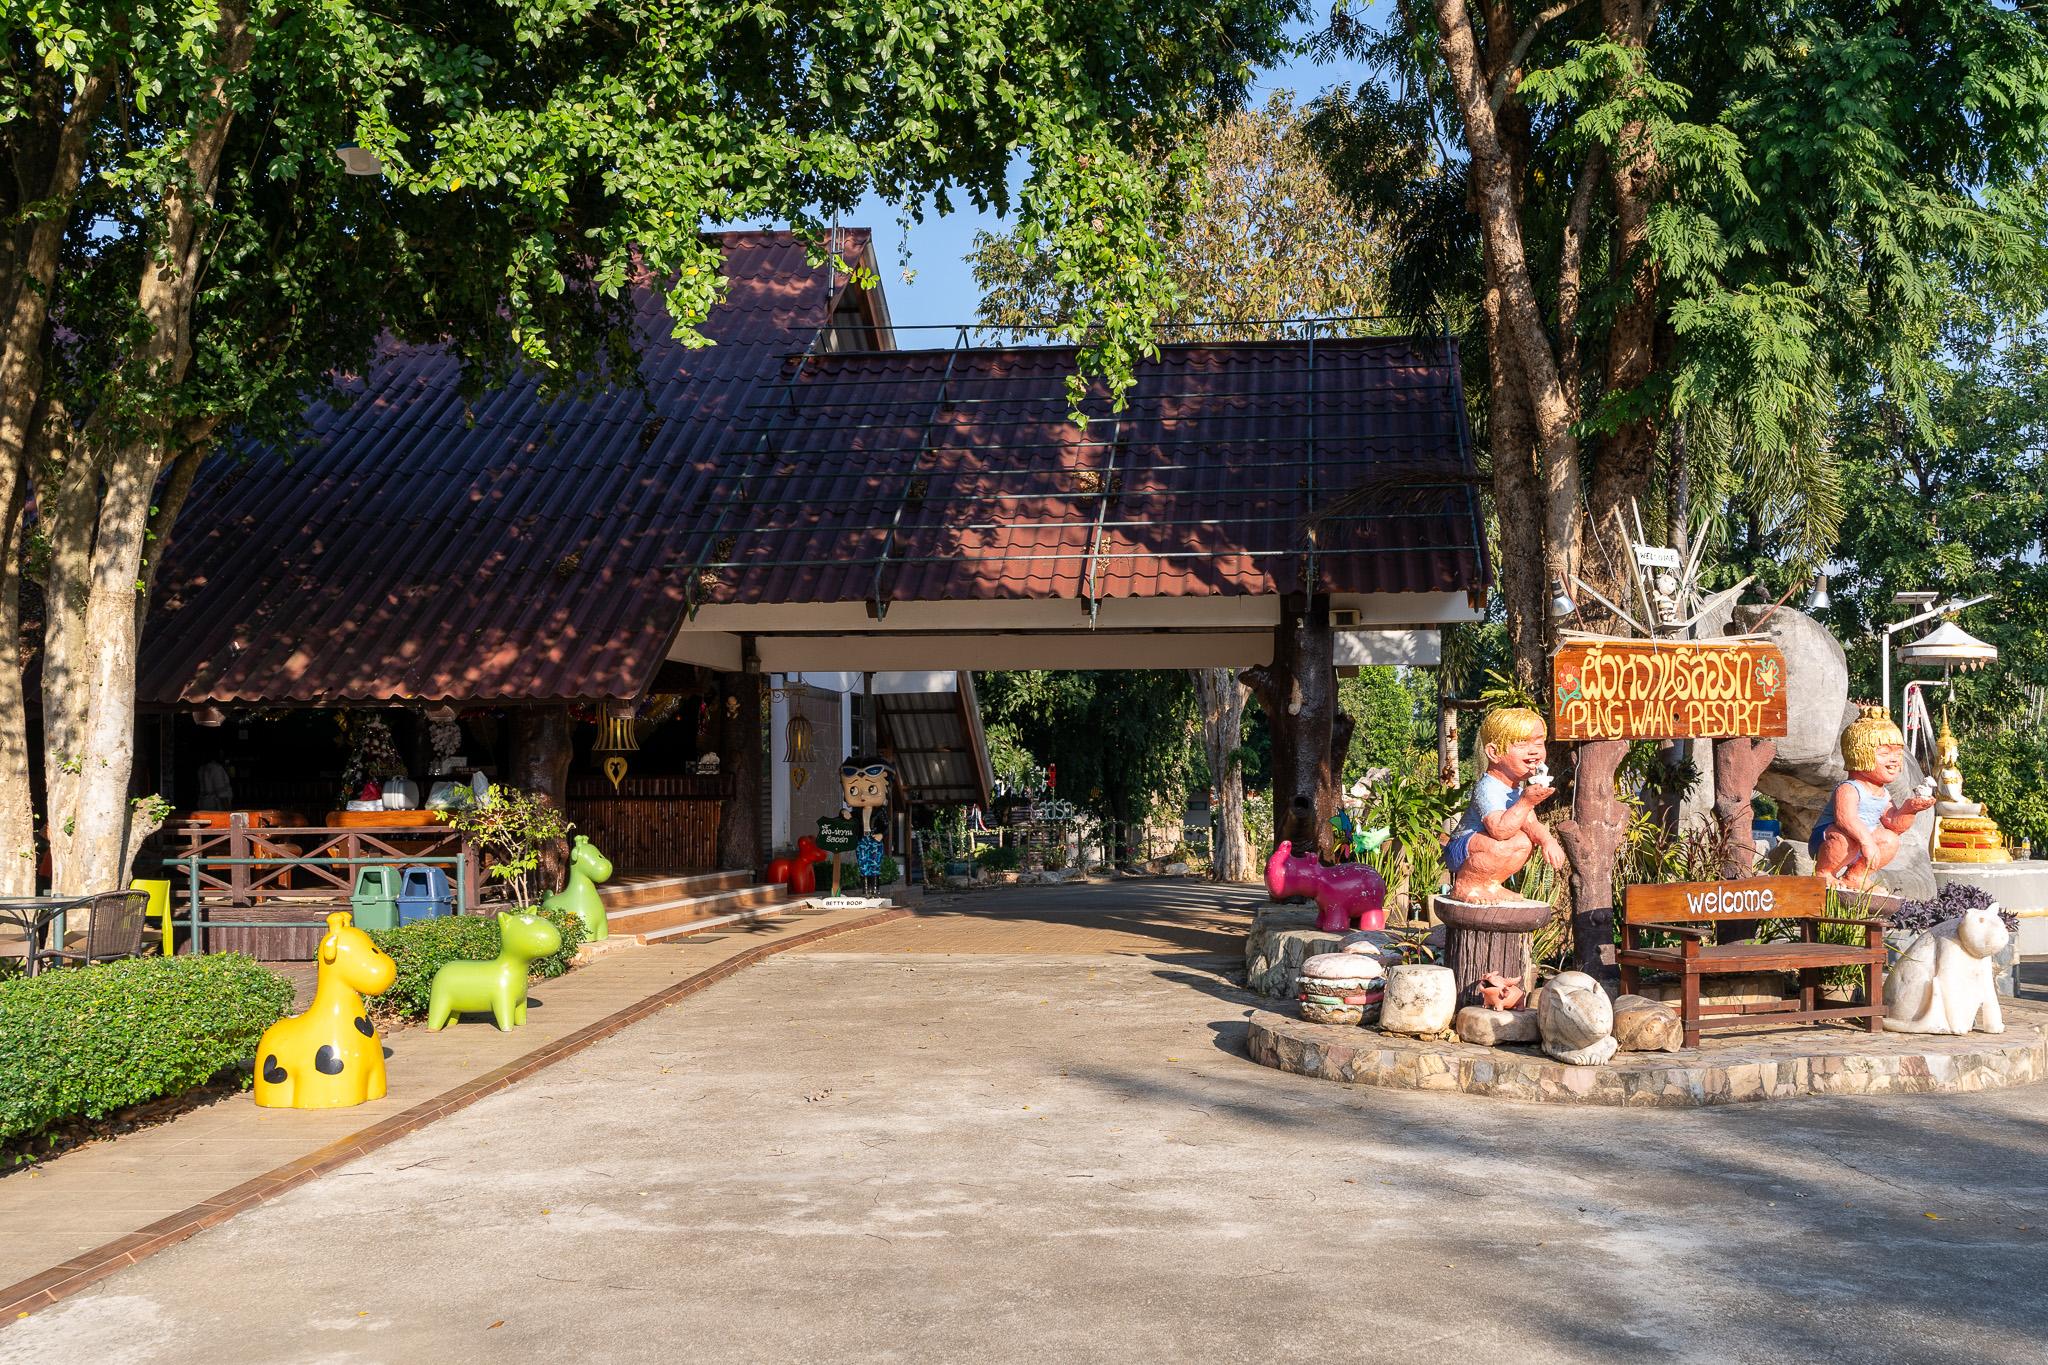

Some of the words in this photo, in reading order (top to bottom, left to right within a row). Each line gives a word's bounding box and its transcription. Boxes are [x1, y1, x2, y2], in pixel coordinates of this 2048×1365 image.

[1566, 699, 1626, 740] PUNG
[1626, 699, 1677, 737] WAAN
[1684, 697, 1771, 738] RESORT
[1687, 886, 1774, 914] welcome
